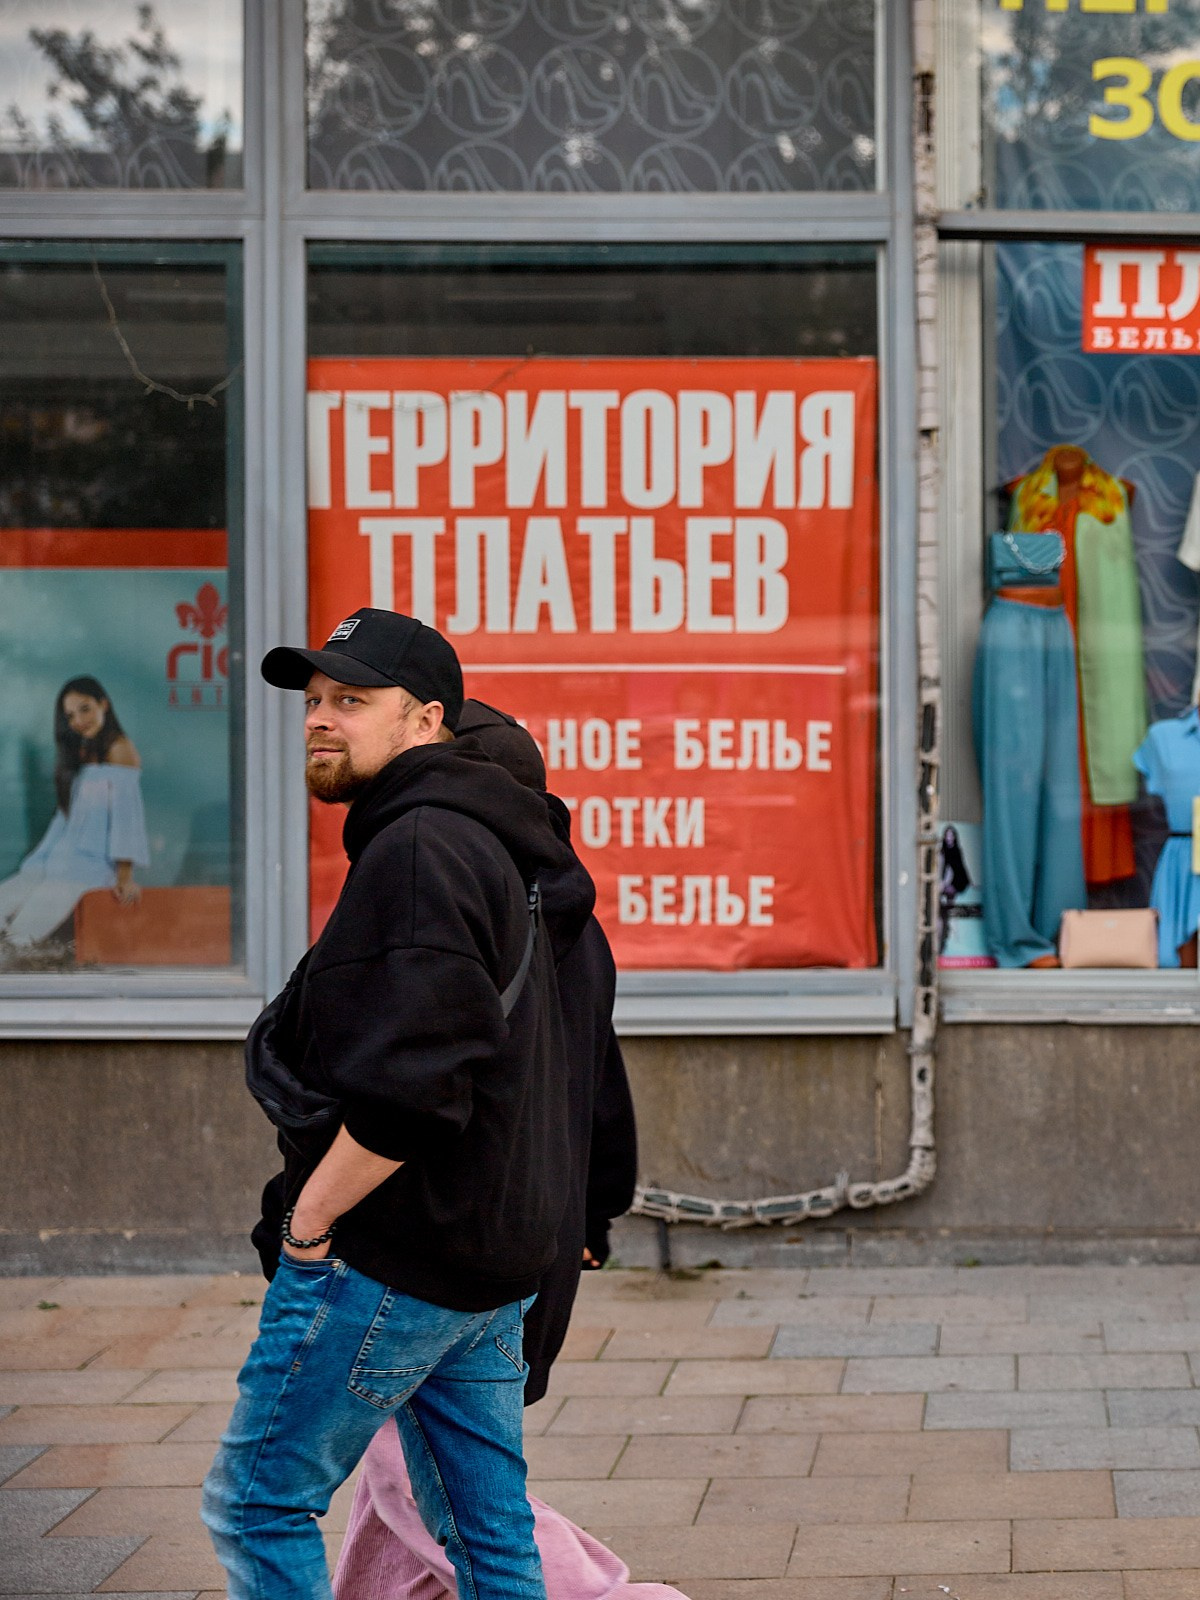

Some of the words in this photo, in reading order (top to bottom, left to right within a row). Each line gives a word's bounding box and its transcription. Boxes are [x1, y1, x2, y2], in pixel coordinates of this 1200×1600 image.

[307, 389, 855, 510] ТЕРРИТОРИЯ
[358, 516, 789, 635] ПЛАТЬЕВ
[516, 718, 642, 771] НОЕ
[674, 718, 833, 772] БЕЛЬЕ
[617, 874, 775, 927] БЕЛЬЕ
